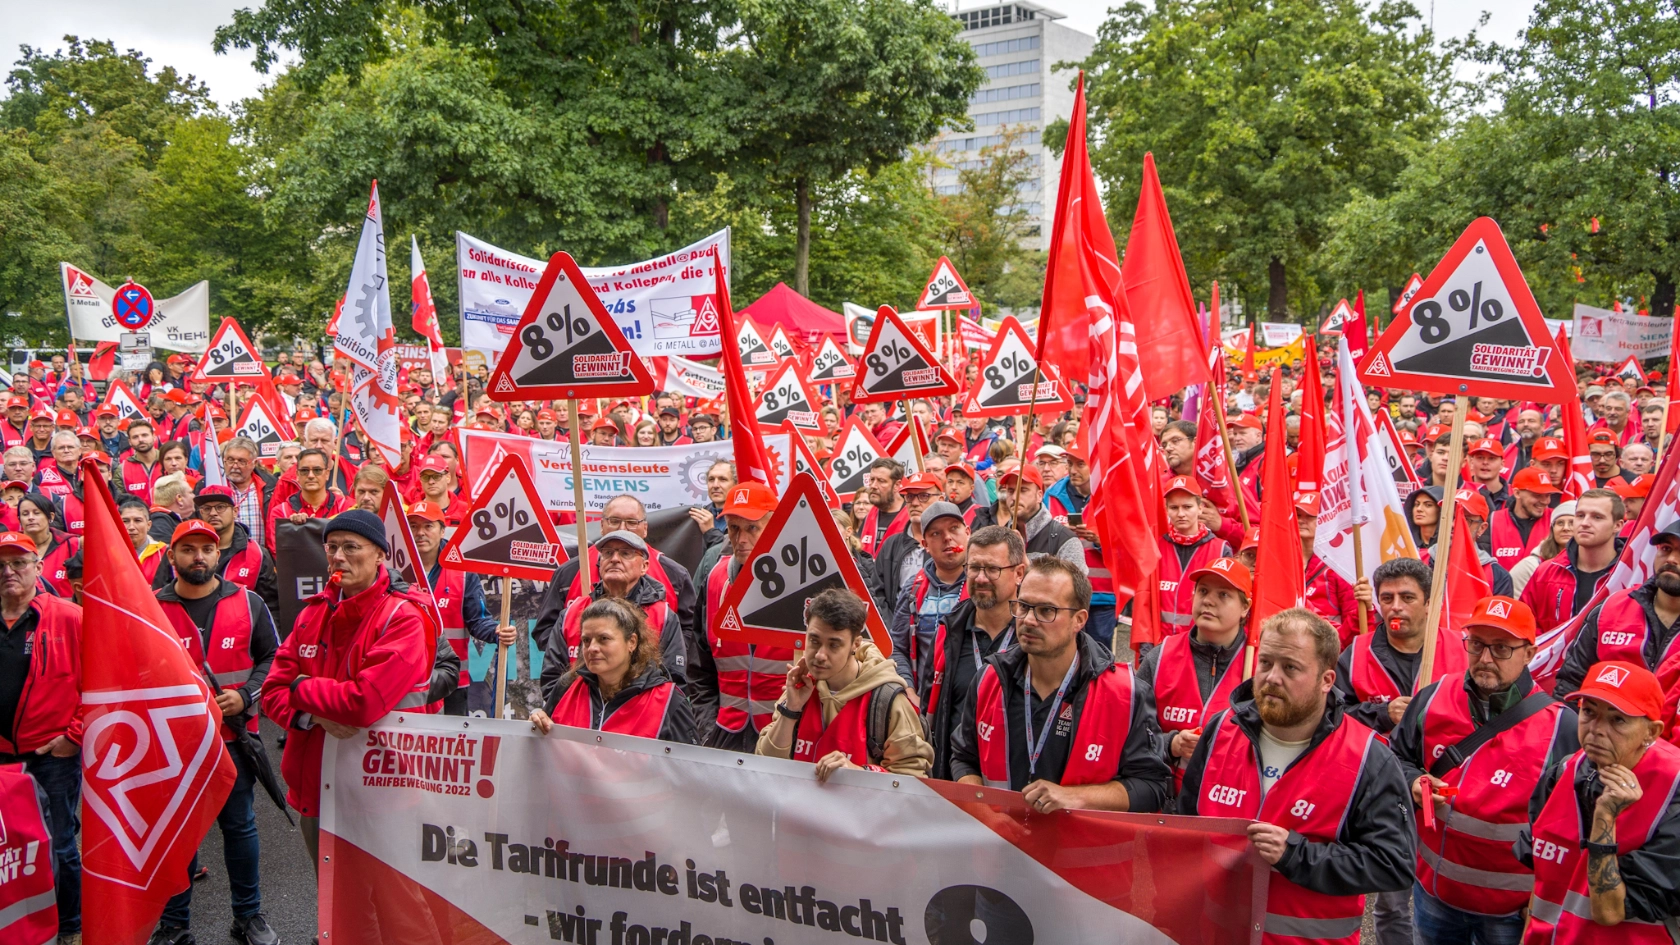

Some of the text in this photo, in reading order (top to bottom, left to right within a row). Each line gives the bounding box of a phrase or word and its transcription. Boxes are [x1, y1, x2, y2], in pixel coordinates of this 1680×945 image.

[481, 270, 502, 284] alle
[504, 274, 538, 290] Kolle
[592, 283, 610, 293] nd
[681, 266, 703, 280] die
[167, 330, 207, 341] DIEHL
[1640, 332, 1671, 341] SIEM
[653, 342, 663, 350] IG
[665, 340, 696, 350] METALL
[709, 338, 721, 347] AU
[1474, 344, 1537, 359] SOLIDARITÄT
[574, 353, 621, 363] SOLIDARITÄT
[1472, 354, 1535, 370] GEWINNT
[574, 361, 621, 373] GEWINNT
[1471, 364, 1515, 374] TARIFBEWEGUNG
[539, 459, 670, 474] Vertauensleute
[128, 482, 146, 491] GEBT
[564, 477, 650, 492] SEMENS
[70, 521, 84, 529] GEB
[511, 541, 551, 551] SOLIDARITÄT
[511, 547, 549, 559] GEWINNT
[1496, 547, 1521, 557] GEBT
[55, 570, 66, 579] 8!
[238, 567, 249, 578] 8!
[1159, 580, 1178, 592] EBT
[438, 598, 449, 608] 8!
[222, 636, 235, 649] 8!
[1601, 630, 1636, 647] GEBT
[1163, 705, 1197, 724] GEBT
[366, 729, 478, 758] SOLIDARITÄT
[794, 738, 813, 756] BT
[1085, 743, 1104, 762] 8!
[362, 749, 476, 784] GEWINNT
[362, 775, 471, 796] TARIFBEWEGUNG 2022
[1490, 769, 1513, 788] 8!
[1208, 783, 1247, 808] GEBT
[1290, 799, 1316, 821] 8!
[421, 823, 478, 868] Die
[484, 832, 679, 896] Tarifrunde
[686, 858, 733, 907] ist
[739, 882, 906, 945] entfacht
[547, 904, 602, 942] wir
[610, 910, 748, 945] ford
